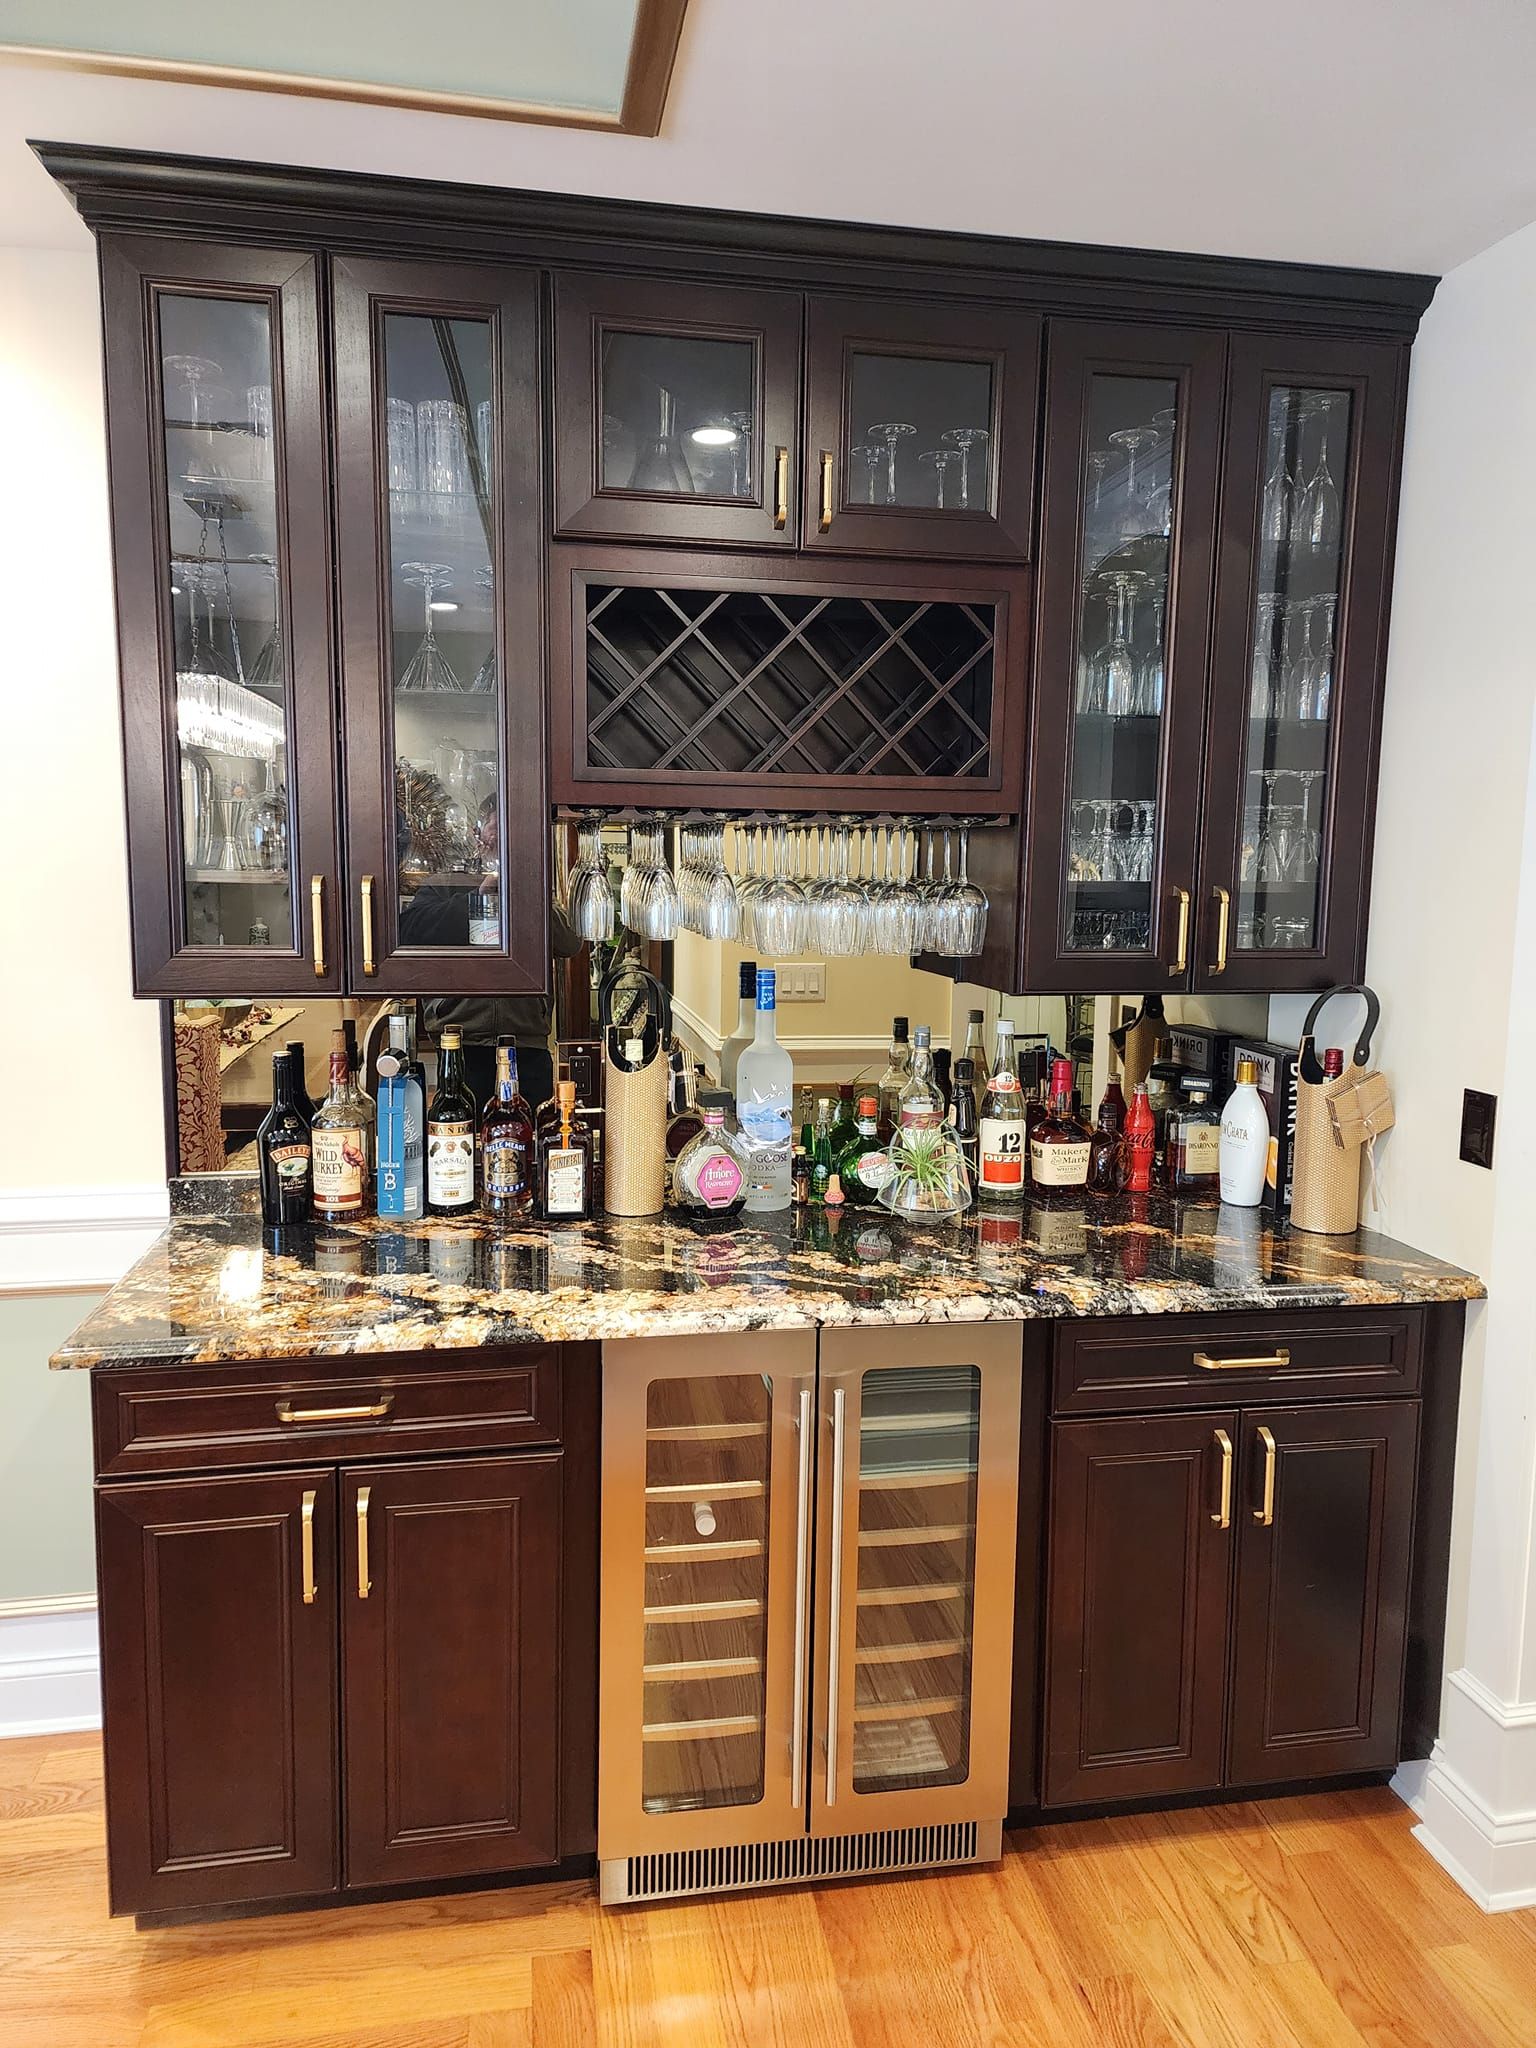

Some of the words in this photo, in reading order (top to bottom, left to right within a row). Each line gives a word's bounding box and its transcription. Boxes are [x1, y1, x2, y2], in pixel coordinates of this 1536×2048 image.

[999, 1133, 1020, 1153] 12
[1188, 1142, 1219, 1150] DISARONNO
[315, 1148, 338, 1161] WILD
[755, 1152, 788, 1164] GOOSE
[985, 1154, 1021, 1163] OUZO
[1063, 1156, 1089, 1164] Mark
[752, 1164, 777, 1172] ODKA
[704, 1168, 735, 1180] Amore
[384, 1172, 397, 1191] B
[325, 1195, 340, 1203] 101
